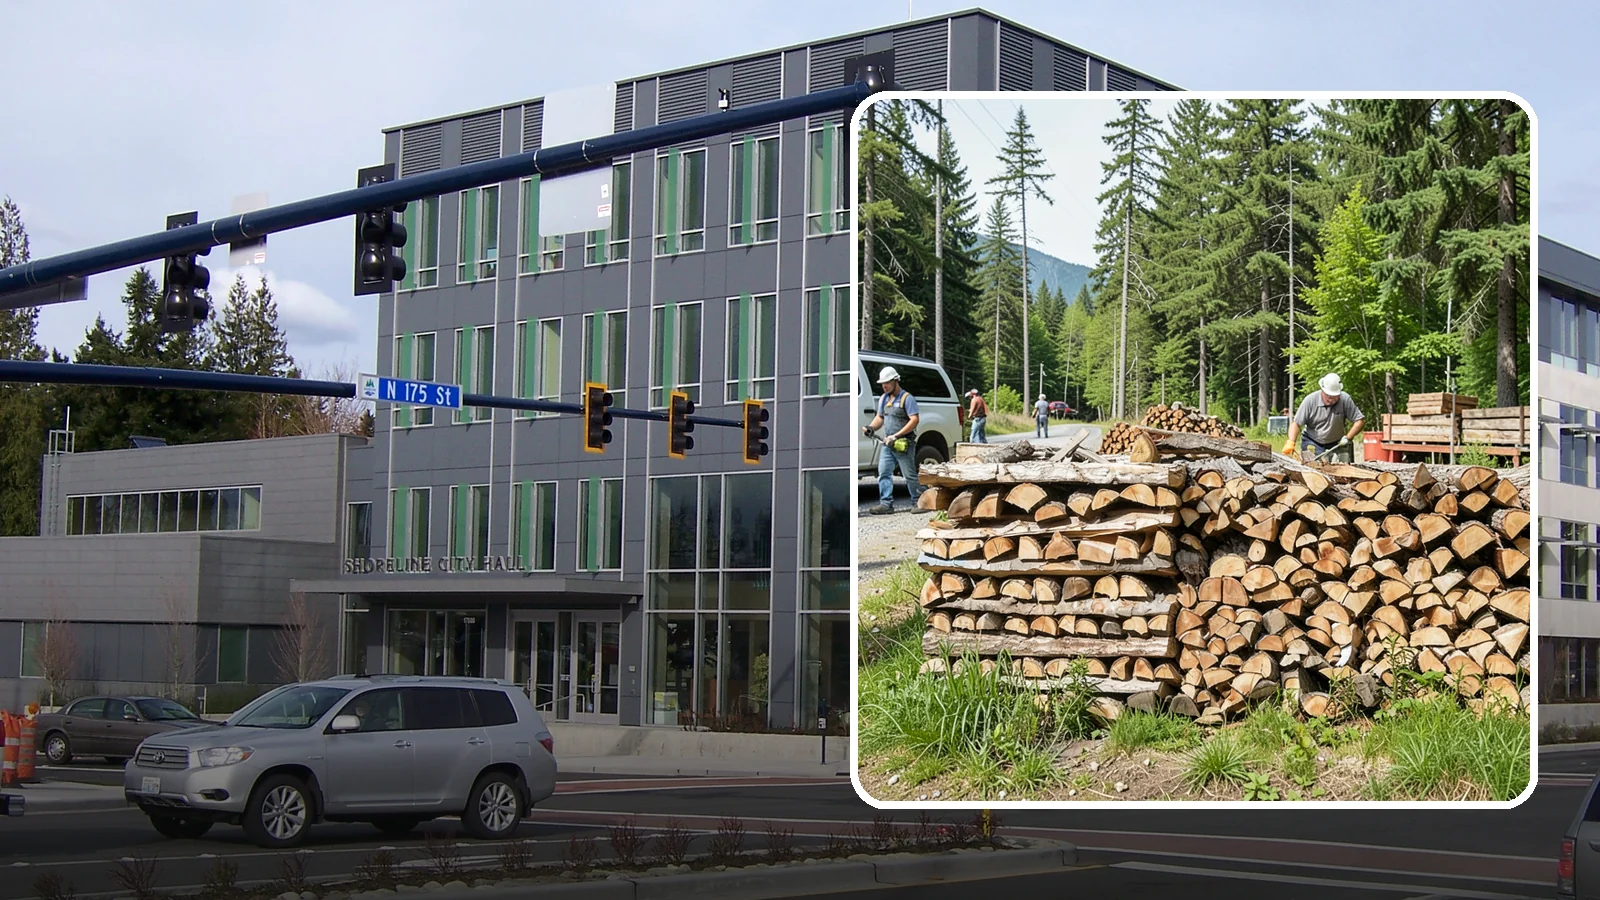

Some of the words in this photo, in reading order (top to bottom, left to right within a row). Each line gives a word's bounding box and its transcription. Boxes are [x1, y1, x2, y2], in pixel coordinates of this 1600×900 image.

[387, 380, 396, 400] N
[405, 382, 427, 403] 175
[436, 386, 451, 406] St
[344, 556, 432, 574] SHORELINE
[438, 556, 476, 573] CITY
[484, 555, 525, 572] HALL
